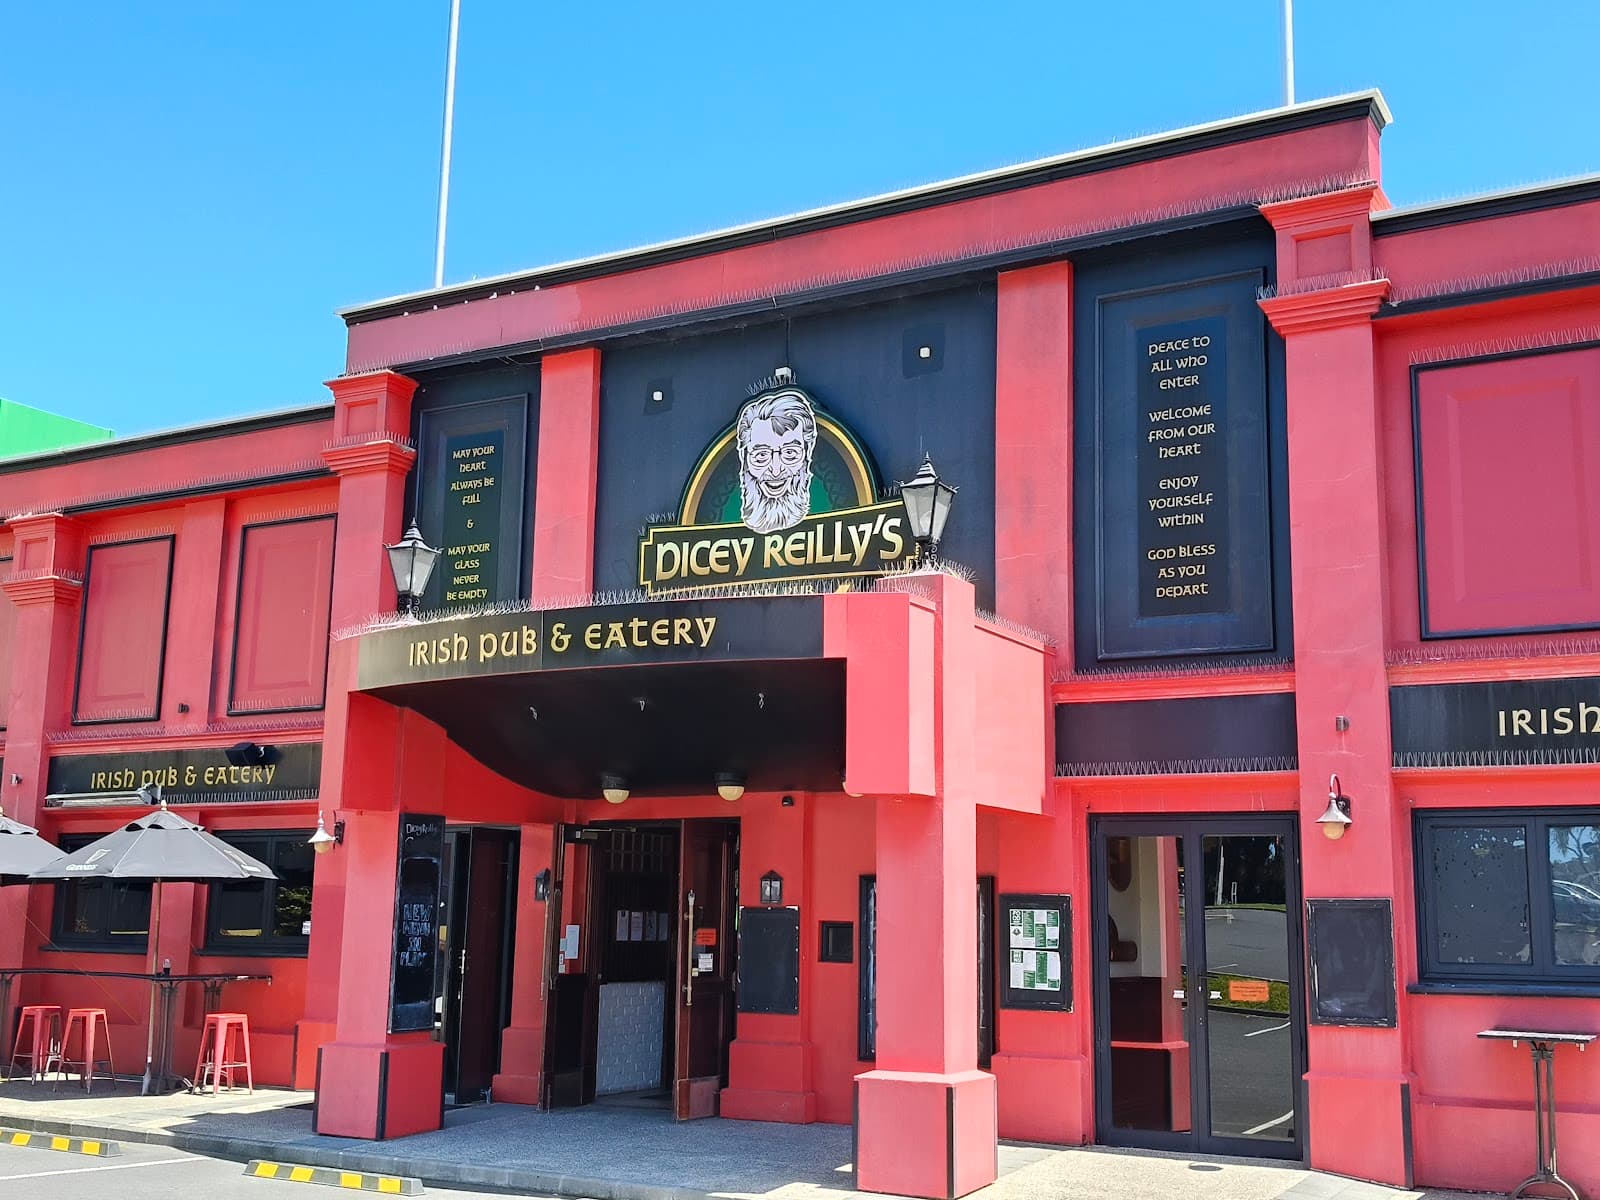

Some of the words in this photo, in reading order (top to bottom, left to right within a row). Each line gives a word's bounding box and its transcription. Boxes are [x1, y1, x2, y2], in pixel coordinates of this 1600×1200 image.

[1148, 339, 1190, 356] PEACE
[1192, 336, 1210, 348] TO
[1151, 359, 1173, 373] ALL
[1175, 355, 1208, 369] WHO
[1159, 375, 1200, 390] ENTER
[1148, 404, 1211, 423] WELCOME
[1147, 427, 1185, 443] FROM
[1187, 423, 1216, 436] OUR
[453, 449, 471, 459] MAY
[472, 445, 495, 457] YOUR
[1159, 443, 1201, 459] HEART
[459, 461, 487, 473] HEART
[450, 479, 483, 491] ALWAYS
[484, 477, 495, 487] BE
[1159, 475, 1199, 490] ENJOY
[462, 493, 481, 506] FULL
[1148, 493, 1214, 511] YOURSELF
[466, 519, 474, 529] &
[1157, 513, 1204, 528] WITHIN
[447, 546, 466, 556] MAY
[467, 543, 490, 555] YOUR
[655, 537, 754, 581] DICEY
[763, 513, 904, 569] REILLY'S
[1147, 548, 1176, 560] GOD
[1179, 544, 1216, 558] BLESS
[454, 559, 480, 570] GLASS
[1158, 567, 1175, 579] AS
[1178, 564, 1206, 578] YOU
[453, 574, 480, 585] NEVER
[446, 591, 457, 601] BE
[458, 588, 488, 600] EMPTY
[1156, 582, 1209, 598] DEPART
[409, 633, 468, 667] IRISH
[479, 625, 538, 662] PUB
[550, 622, 573, 652] &
[584, 616, 717, 650] EATERY
[1498, 702, 1600, 737] IRISH
[90, 768, 135, 789] IRISH
[141, 766, 178, 788] PUB
[184, 765, 197, 787] &
[204, 764, 276, 786] EATERY
